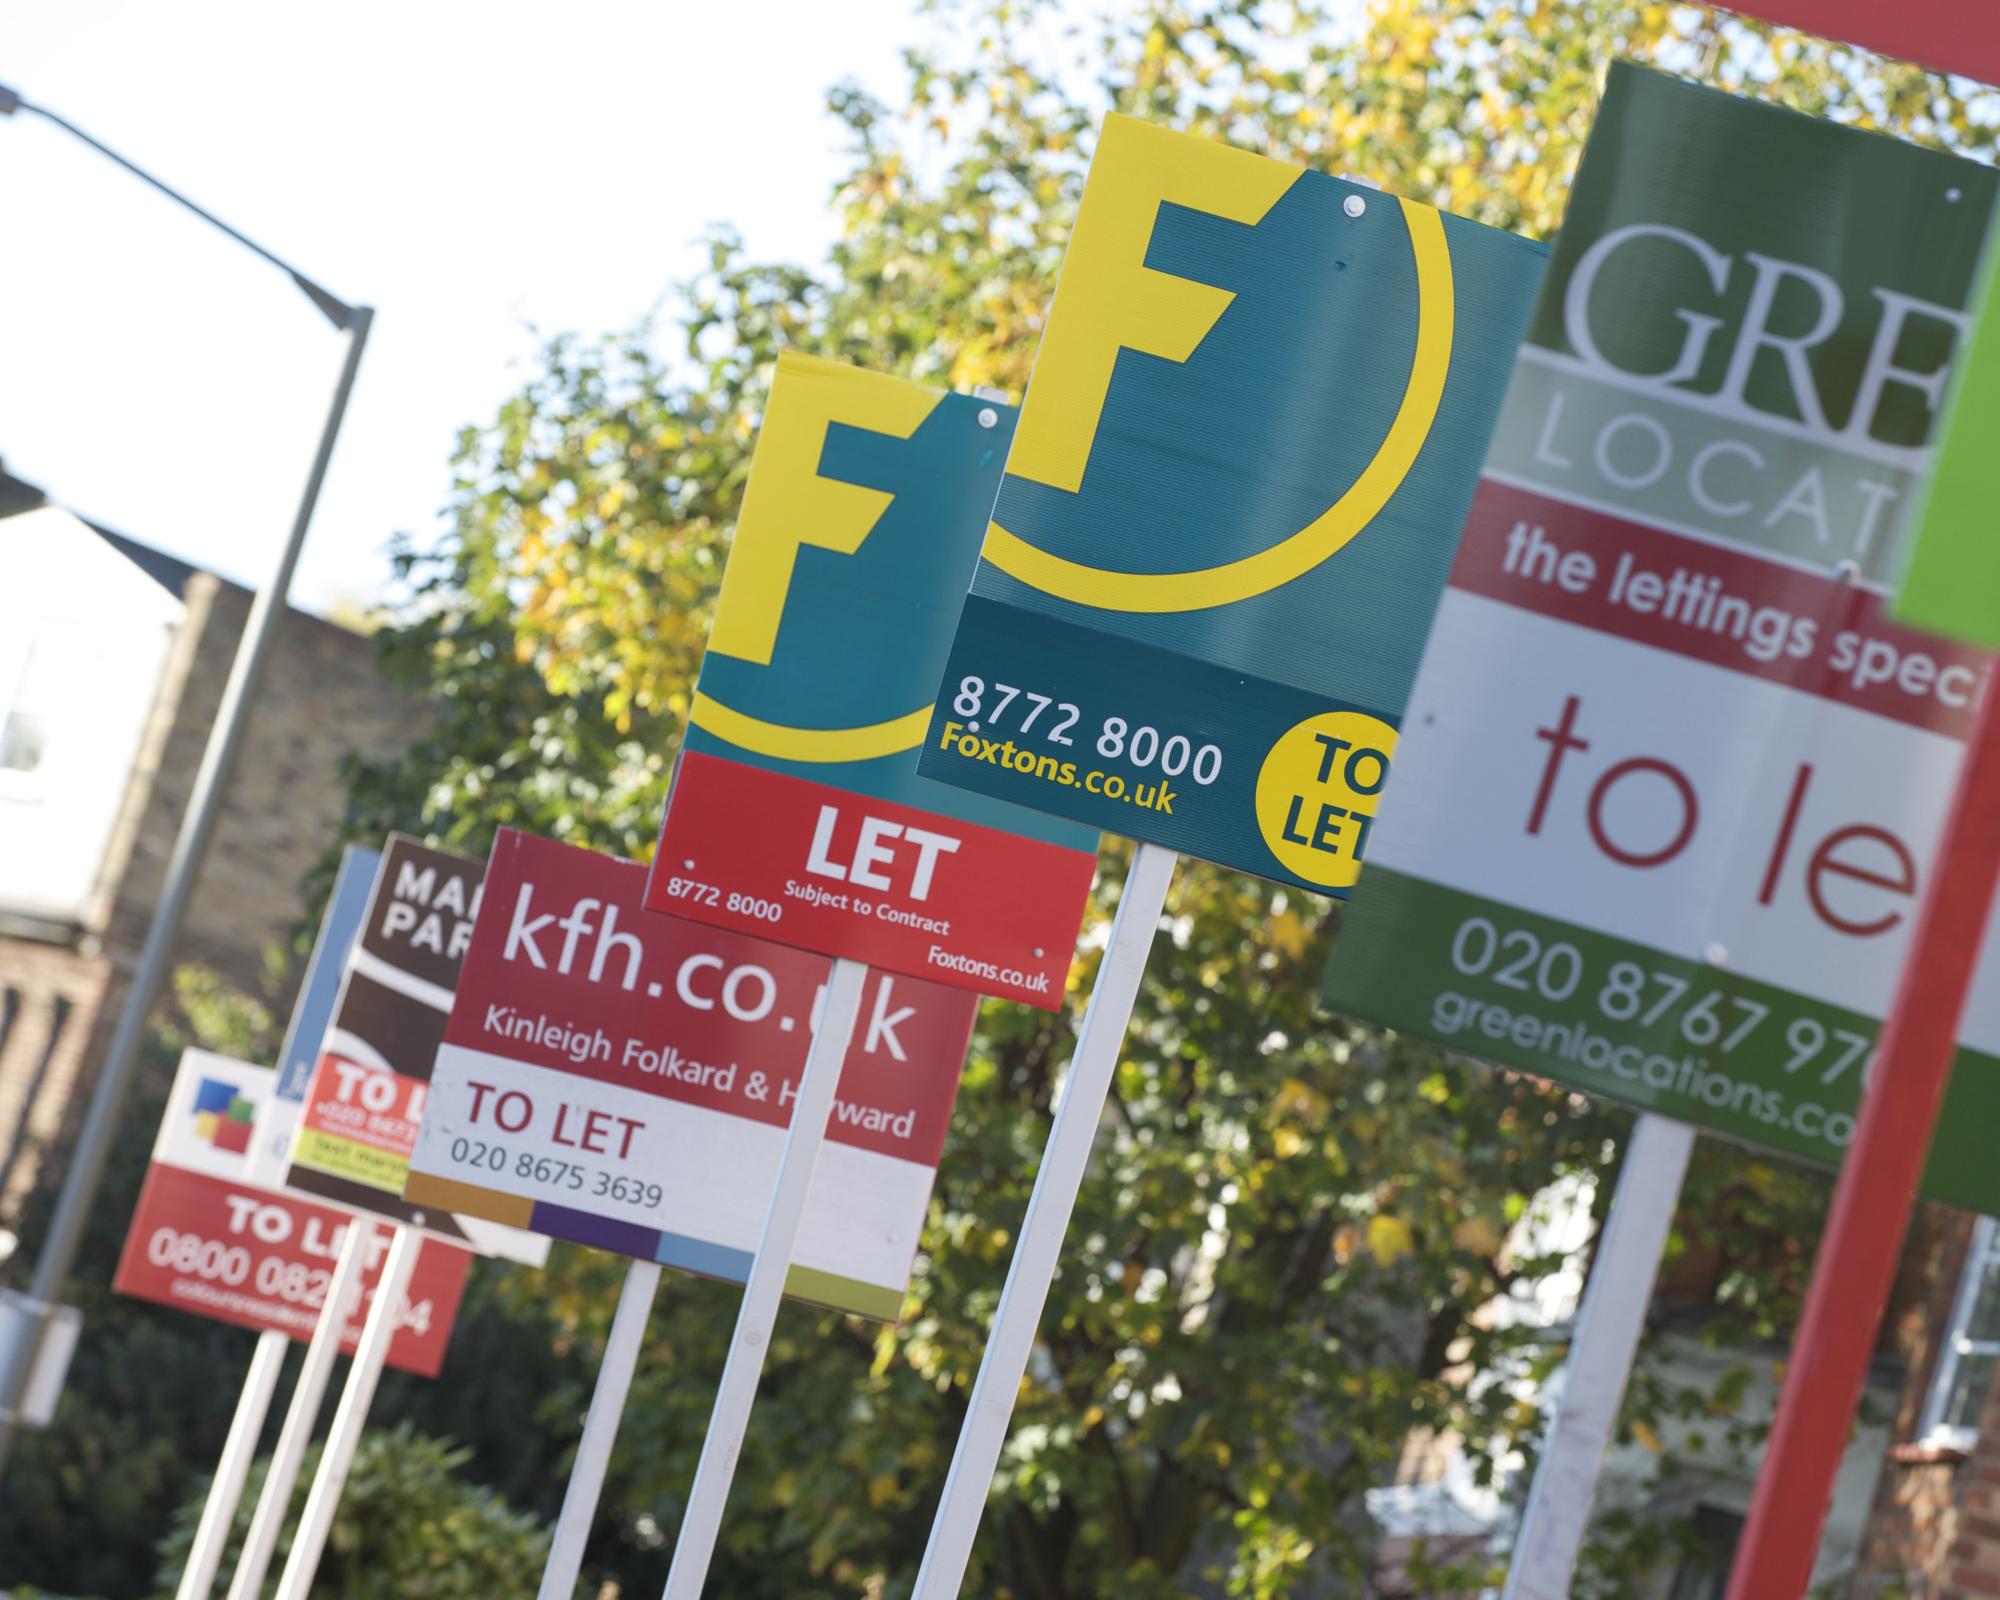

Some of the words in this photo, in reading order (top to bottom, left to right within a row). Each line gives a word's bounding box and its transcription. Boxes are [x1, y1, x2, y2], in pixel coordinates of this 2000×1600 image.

[1563, 223, 1974, 470] GRE
[1535, 391, 1900, 553] LOCAT
[1502, 521, 1596, 593] the
[1608, 553, 1818, 662] lettings
[939, 720, 1178, 815] Foxtons.co.uk
[953, 675, 1080, 747] 8772
[1096, 716, 1223, 786] 8000
[1315, 733, 1392, 796] TO
[805, 804, 962, 901] LET
[1281, 794, 1375, 862] LET
[1526, 695, 1699, 869] to
[1757, 763, 1917, 938] le
[381, 901, 474, 959] PAR
[666, 877, 721, 907] 8772
[726, 892, 783, 923] 8000
[784, 879, 848, 914] Subject
[852, 897, 872, 915] to
[875, 903, 951, 936] Contract
[927, 945, 1049, 994] Foxtons.co.uk
[1450, 917, 1583, 1001] 020
[1598, 961, 1770, 1053] 8767
[334, 1060, 397, 1113] TO
[483, 1004, 611, 1064] Kinleigh
[622, 1038, 738, 1093] Folkard
[743, 1071, 769, 1102] &
[778, 1079, 916, 1139] Hward
[1431, 990, 1858, 1147] greenlocations.co
[465, 1080, 534, 1133] TO
[551, 1101, 645, 1160] LET
[450, 1138, 507, 1172] 020
[515, 1153, 584, 1190] 8675
[592, 1171, 664, 1209] 3639
[148, 1227, 251, 1286] 0800
[225, 1194, 293, 1244] TO
